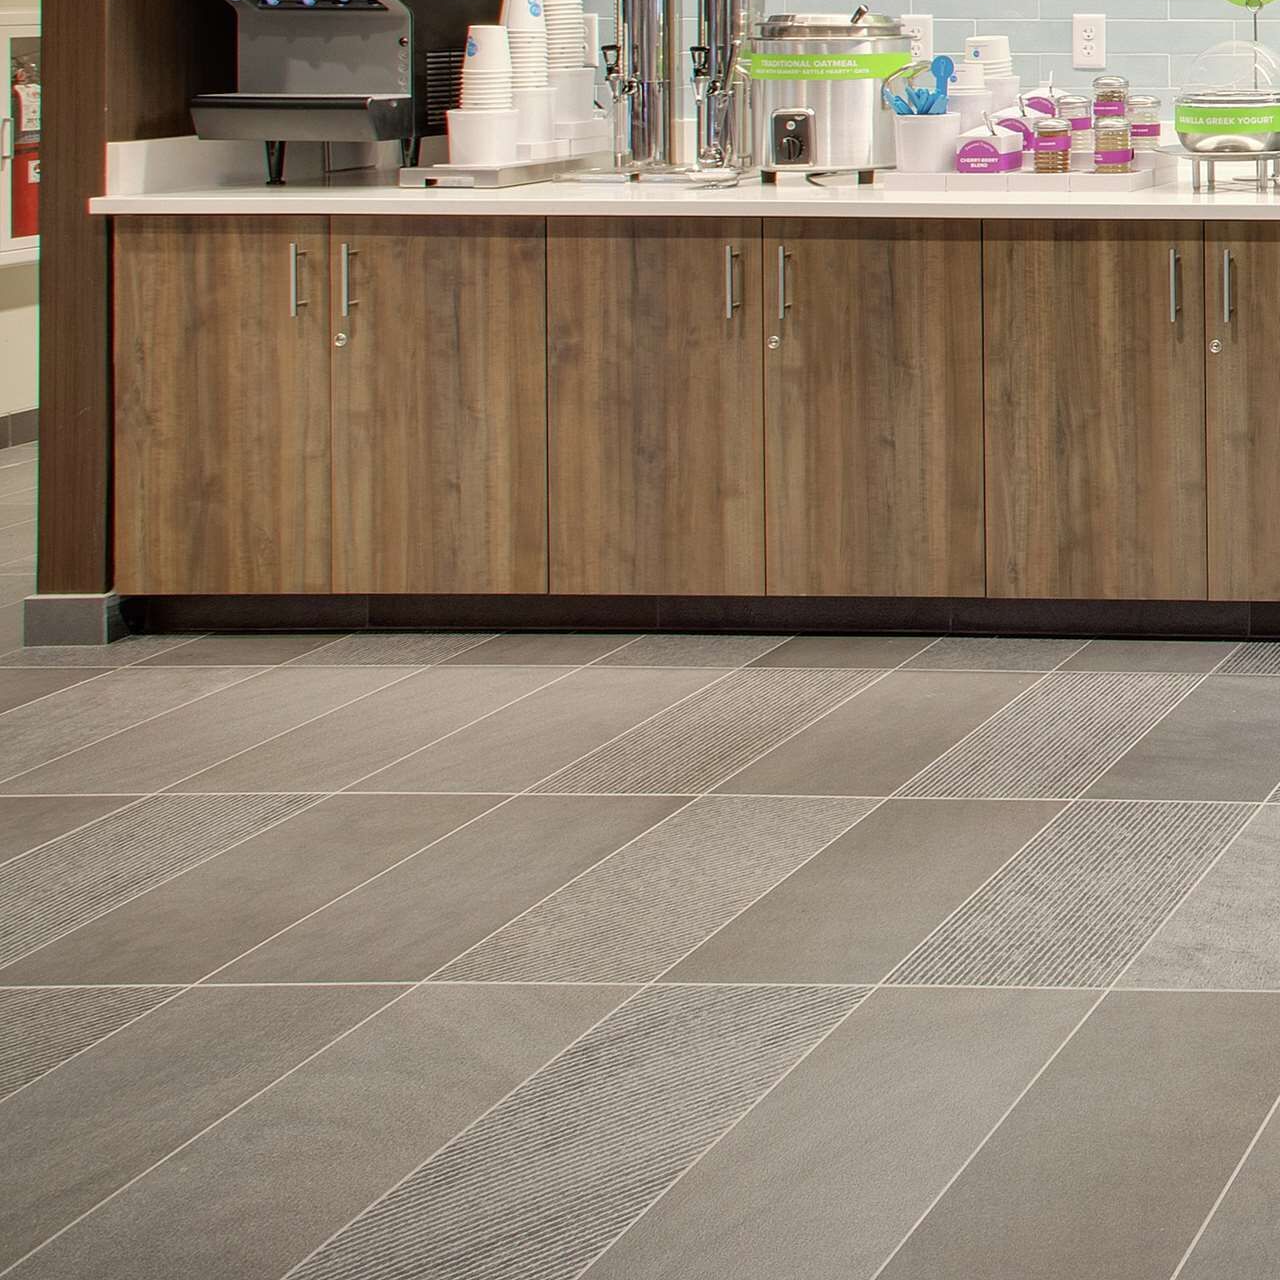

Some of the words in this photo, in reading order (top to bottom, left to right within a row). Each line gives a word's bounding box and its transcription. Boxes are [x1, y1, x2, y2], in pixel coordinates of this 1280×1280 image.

[814, 59, 857, 67] OATMEAL
[1206, 117, 1234, 125] GREEK
[1236, 116, 1274, 124] YOGURT
